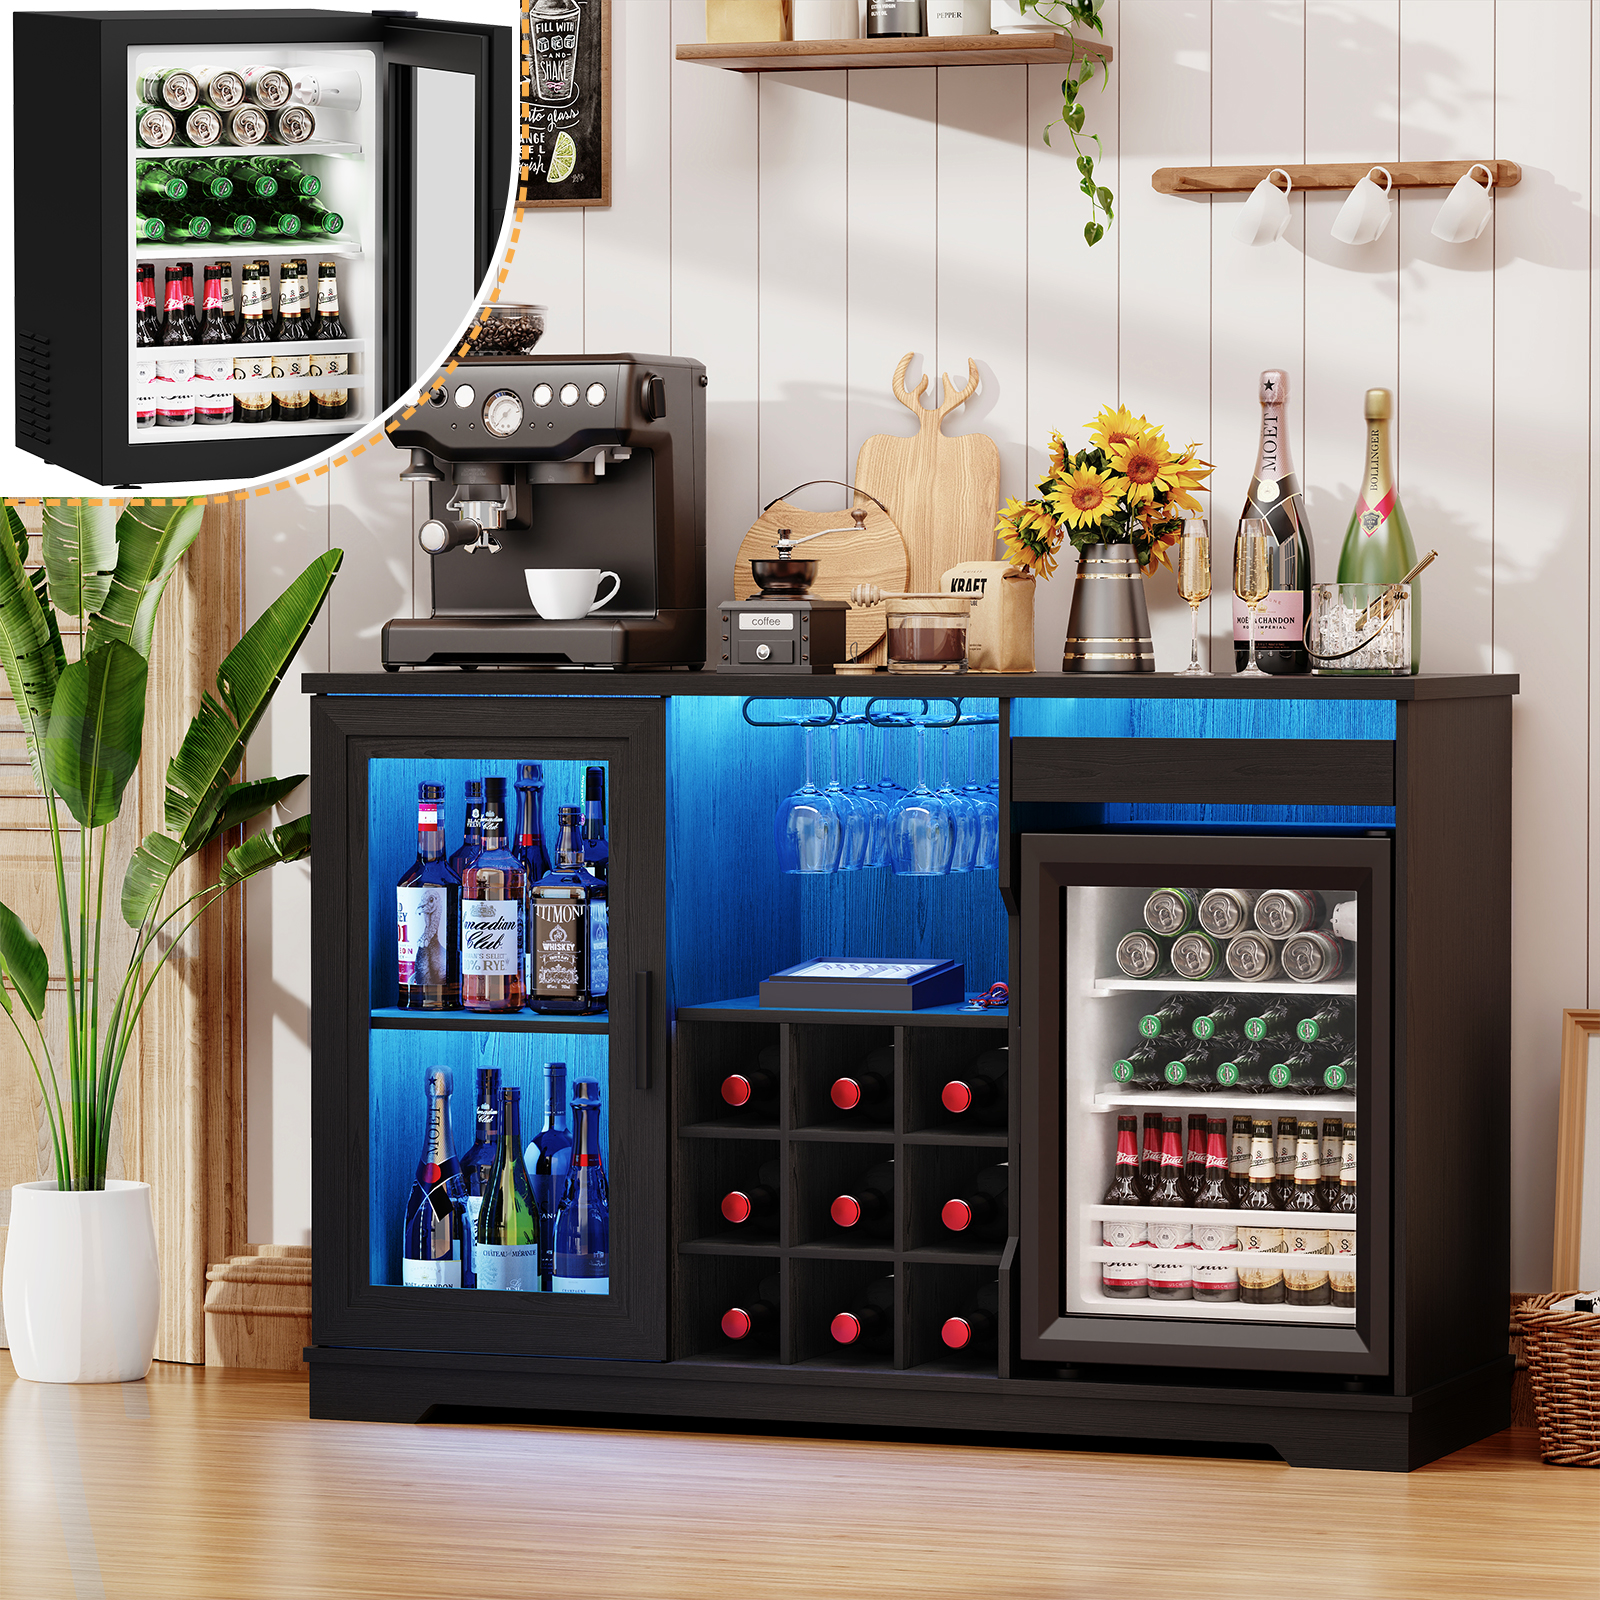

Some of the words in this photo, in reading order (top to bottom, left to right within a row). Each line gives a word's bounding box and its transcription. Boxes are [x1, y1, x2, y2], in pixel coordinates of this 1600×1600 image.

[936, 11, 963, 19] PEPPER
[535, 22, 554, 34] FILL
[555, 21, 575, 32] WITH
[540, 60, 569, 81] SHAKE
[547, 108, 580, 132] glass
[1370, 429, 1380, 491] BOLLINGER
[950, 577, 988, 594] KRAFT
[751, 616, 781, 626] coffee
[1258, 616, 1295, 625] CHANDON
[465, 930, 505, 950] Club
[542, 943, 576, 951] WHISKEY
[483, 960, 506, 971] RYE
